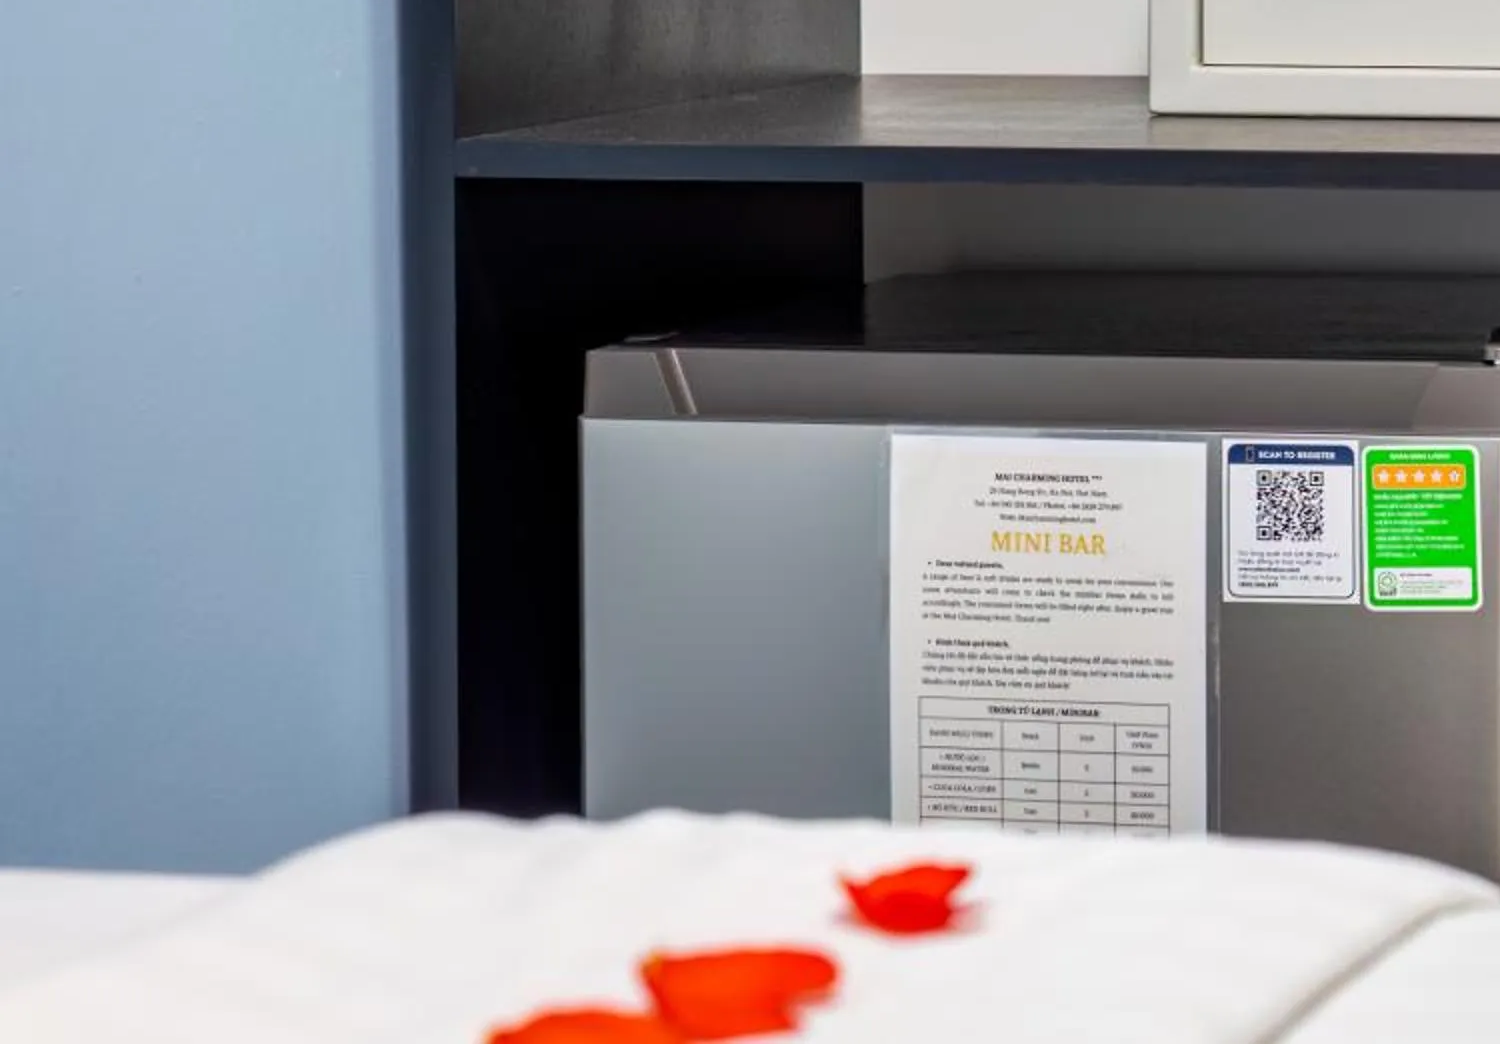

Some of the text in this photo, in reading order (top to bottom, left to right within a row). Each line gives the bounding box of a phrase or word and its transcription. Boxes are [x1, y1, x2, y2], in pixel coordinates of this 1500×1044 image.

[1258, 450, 1283, 459] SCAN
[1283, 450, 1296, 460] TO
[1013, 473, 1061, 483] CHARMING
[991, 530, 1107, 556] MINI BAR
